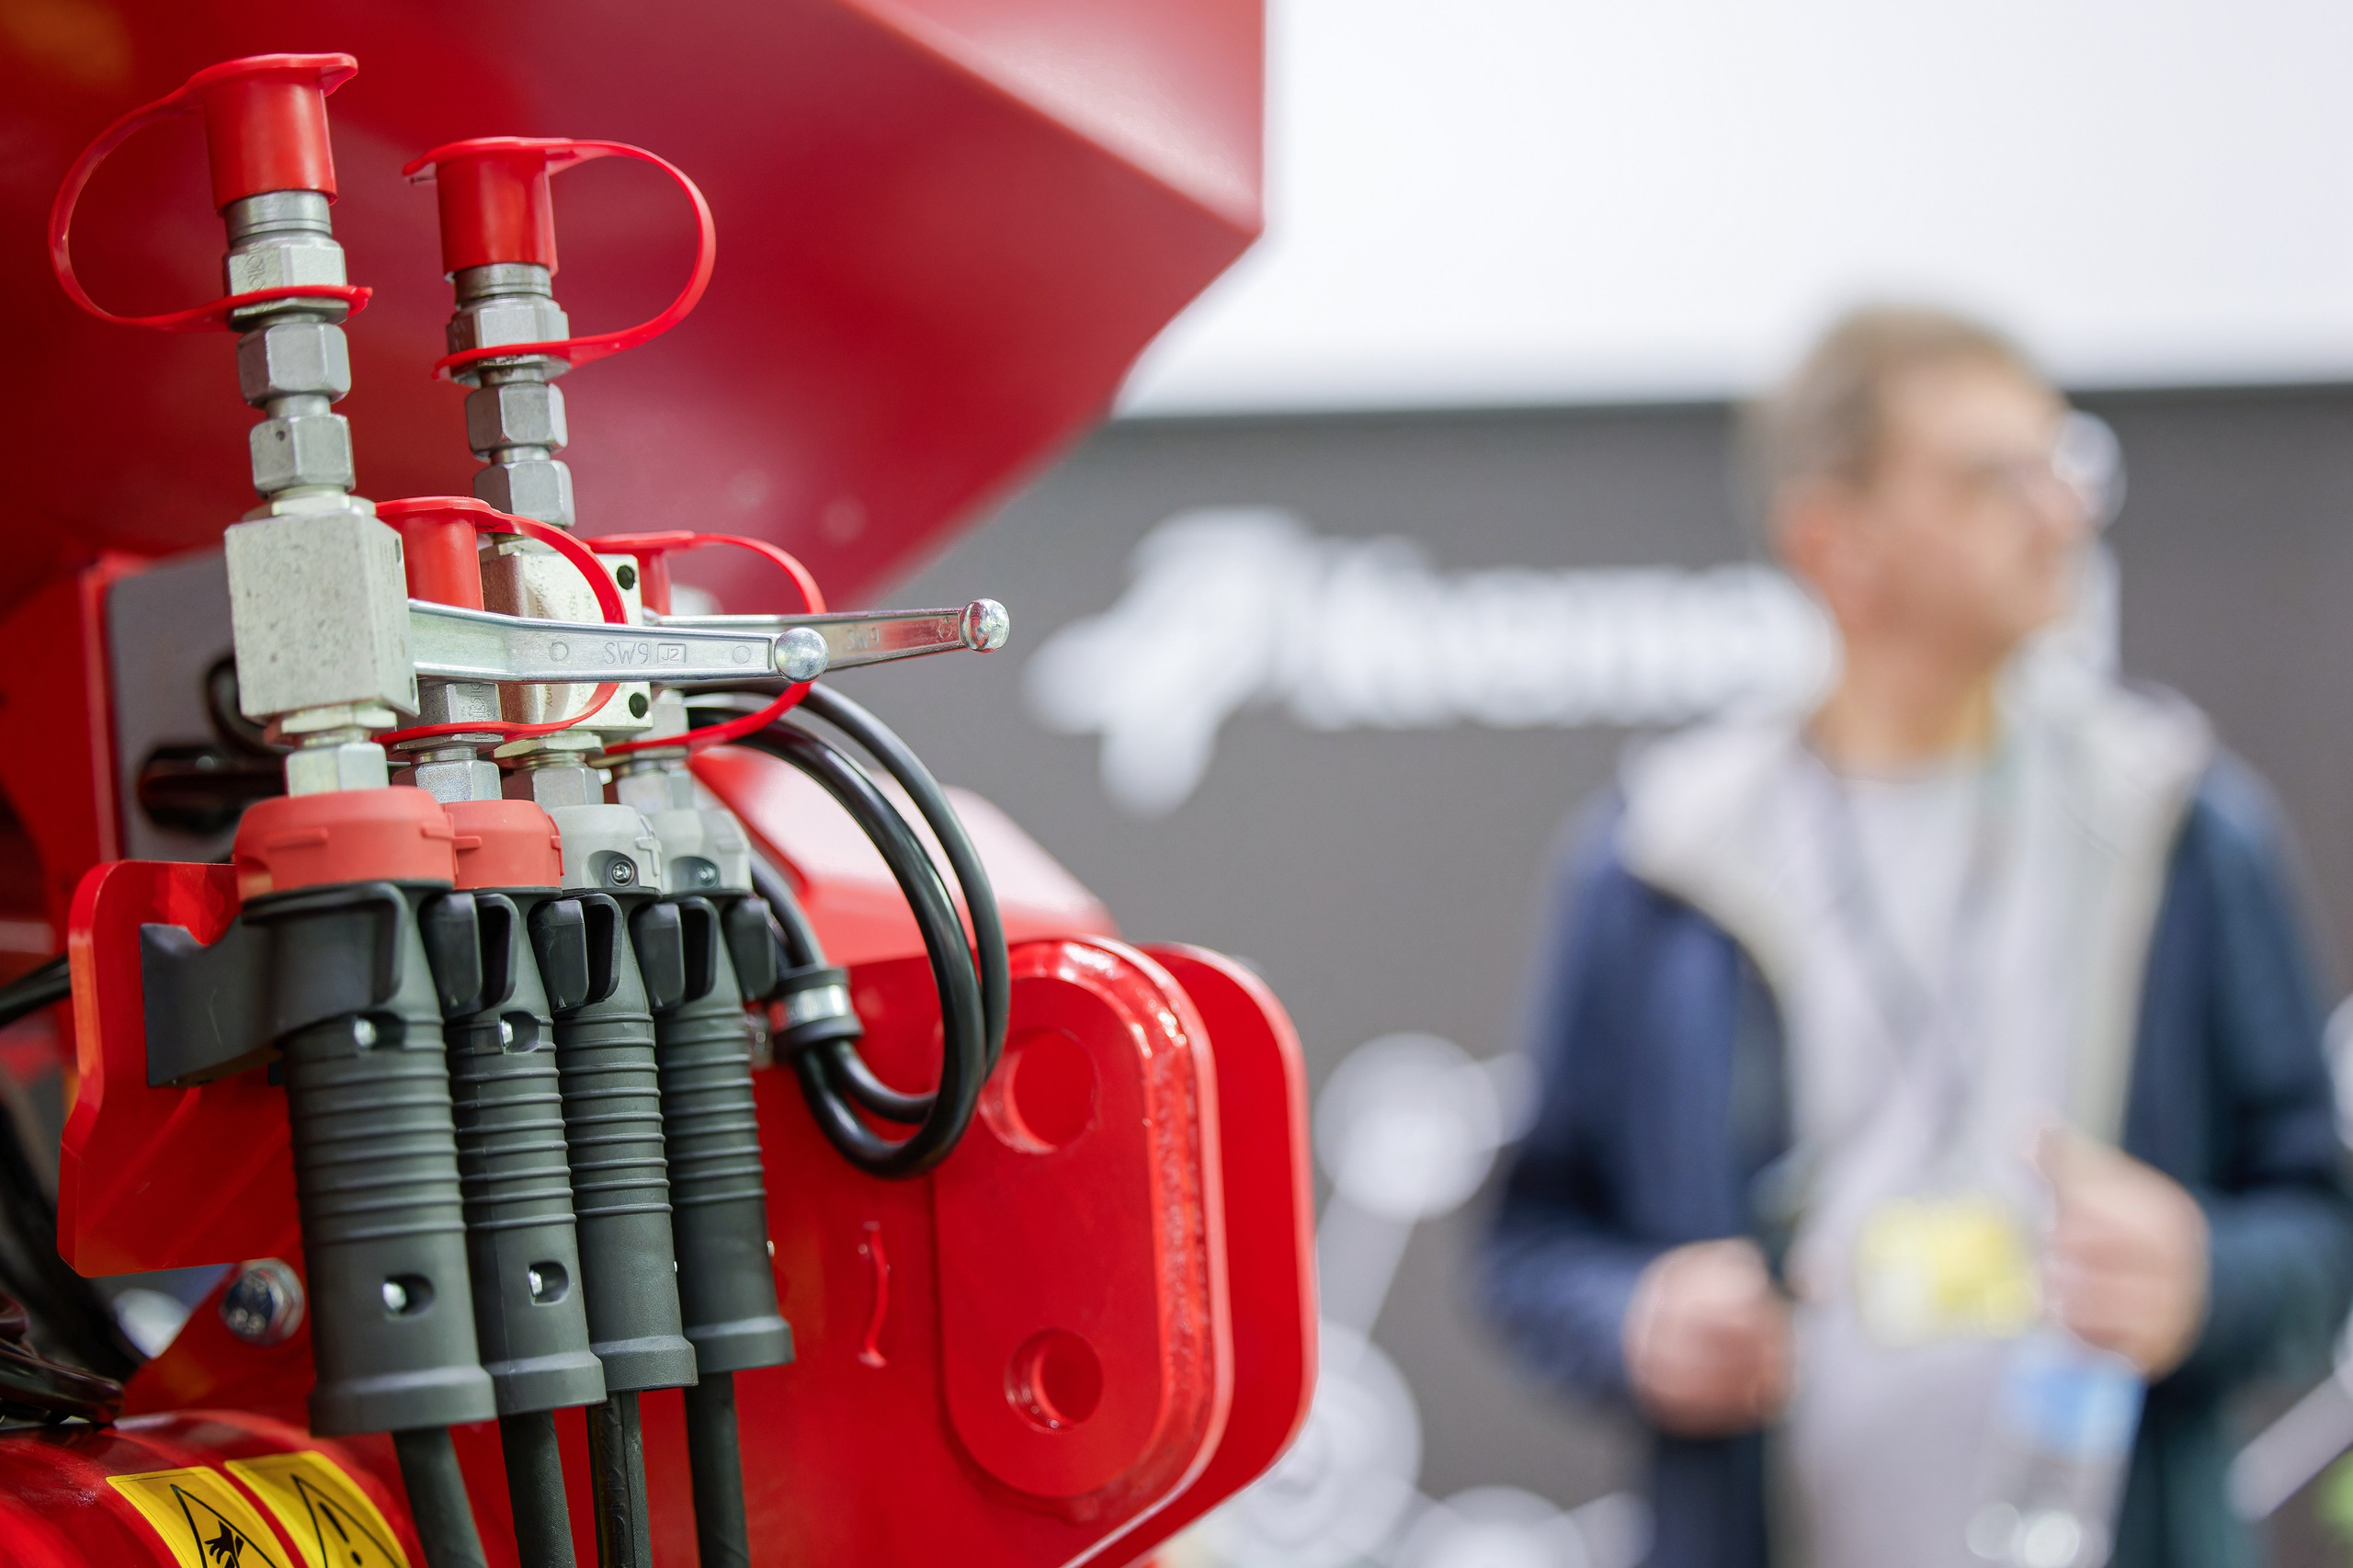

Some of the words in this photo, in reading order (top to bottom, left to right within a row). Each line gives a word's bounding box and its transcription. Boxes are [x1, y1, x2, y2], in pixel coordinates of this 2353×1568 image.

[846, 627, 881, 651] SW9
[603, 642, 650, 665] SW9
[660, 647, 681, 662] J2
